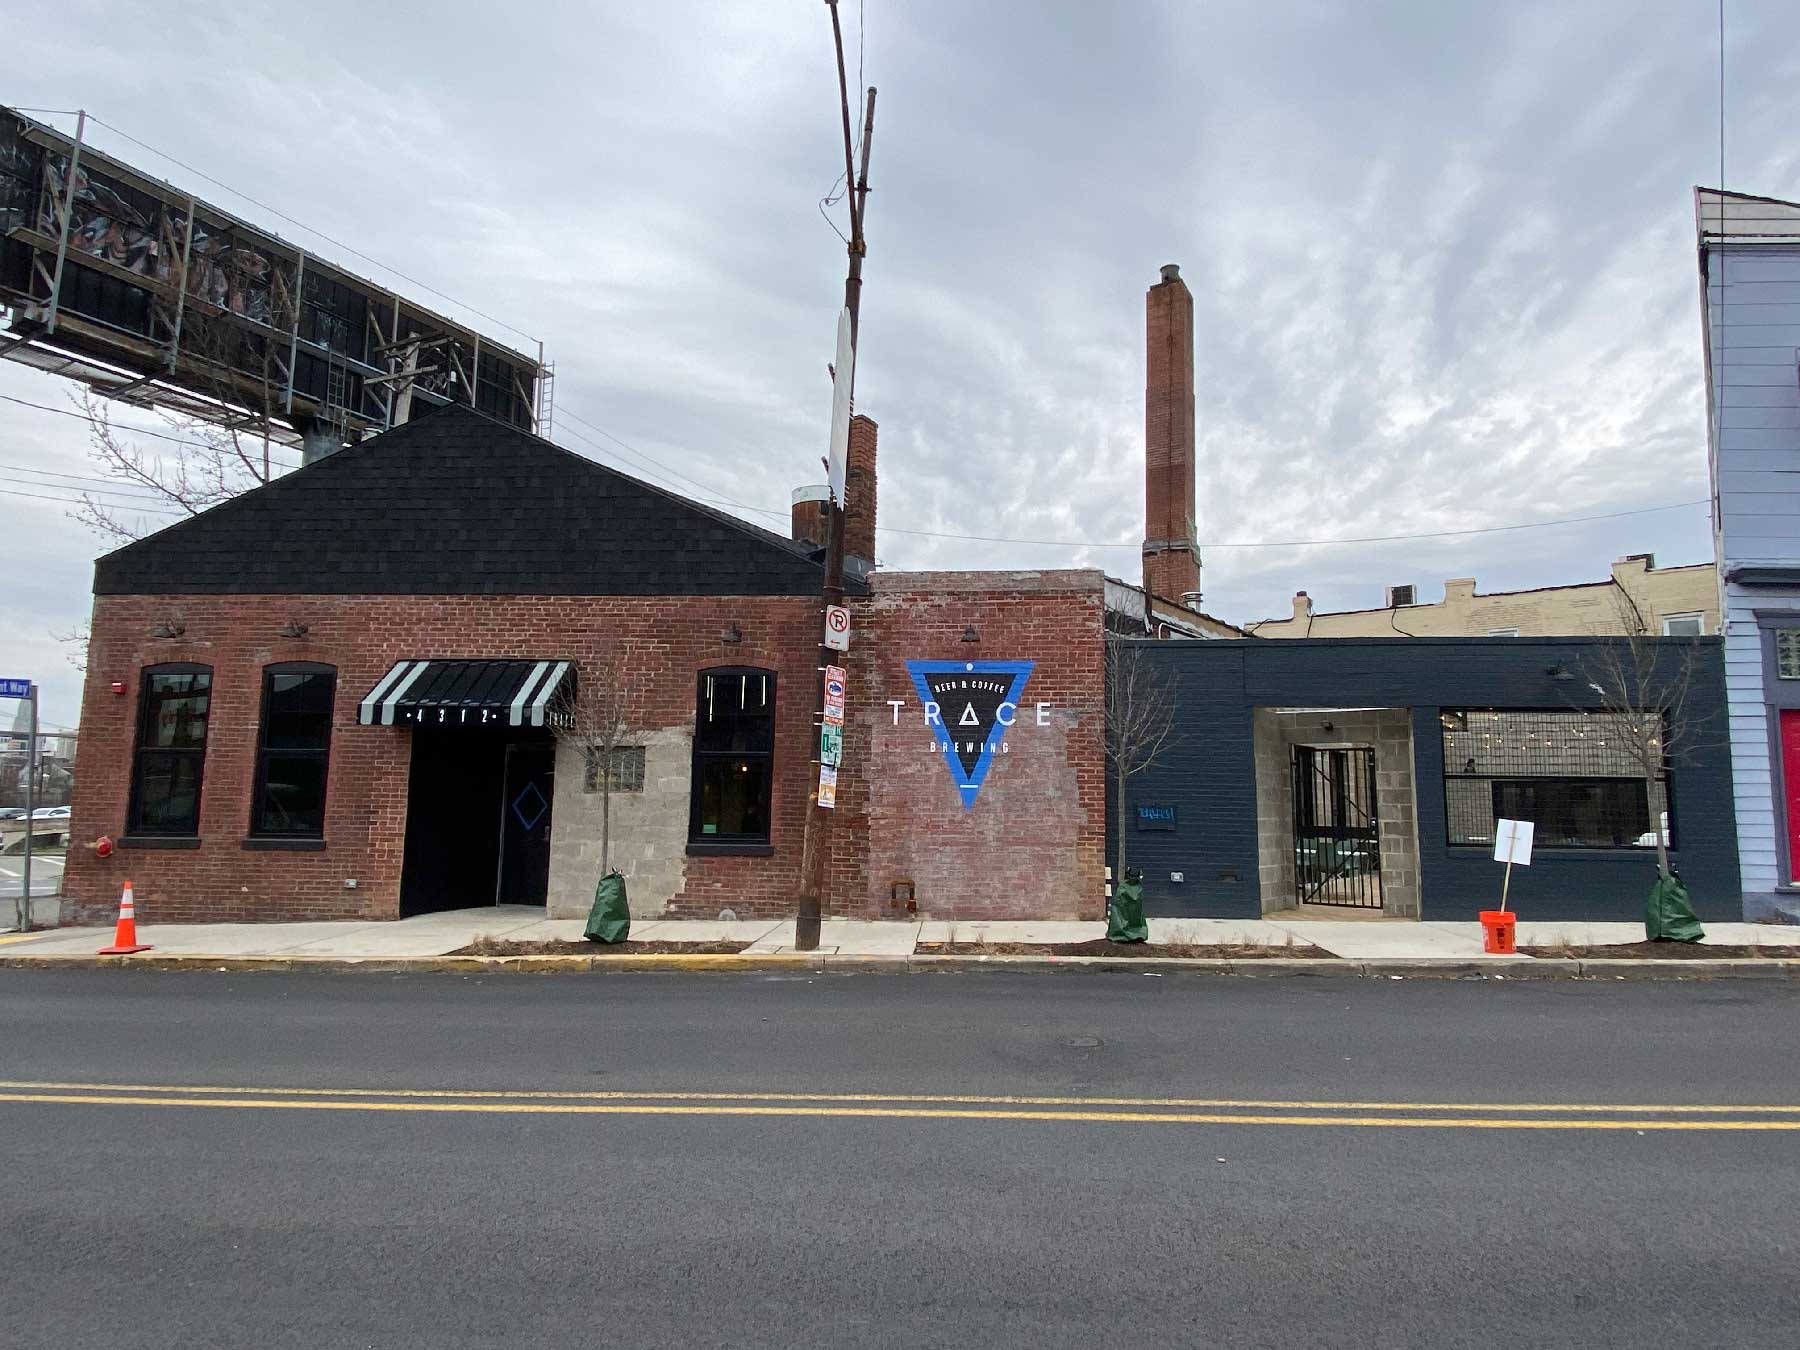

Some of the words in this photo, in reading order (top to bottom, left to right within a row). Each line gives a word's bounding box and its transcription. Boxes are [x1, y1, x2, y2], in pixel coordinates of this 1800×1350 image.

[9, 681, 28, 696] Way
[935, 681, 957, 693] BEER
[962, 681, 967, 689] &
[972, 681, 1005, 694] COFFEE
[417, 708, 488, 723] 4312
[887, 701, 1051, 726] TRACE
[930, 742, 1009, 753] BREWING
